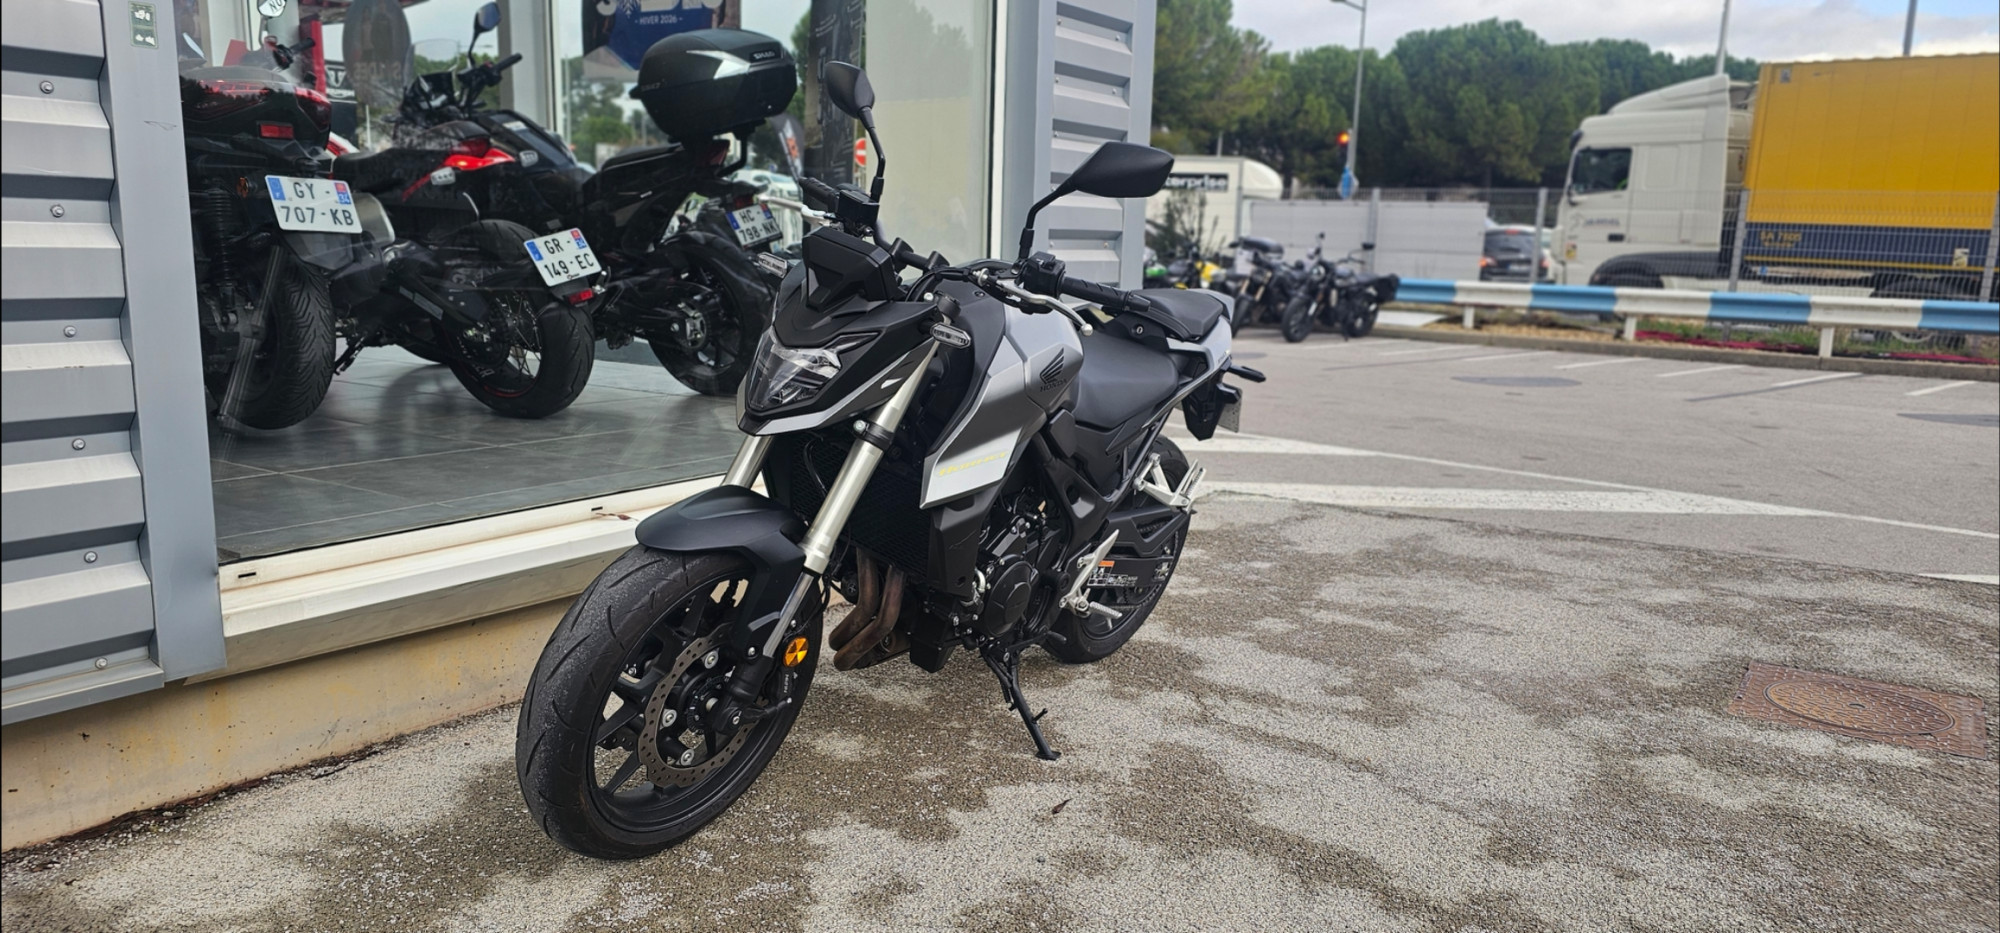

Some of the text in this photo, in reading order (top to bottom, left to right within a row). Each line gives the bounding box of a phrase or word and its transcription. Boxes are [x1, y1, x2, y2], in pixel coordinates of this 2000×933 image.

[639, 15, 659, 25] HIVER
[660, 14, 678, 24] 2026
[1164, 173, 1226, 190] terprise
[280, 205, 354, 226] 707-KB
[544, 253, 595, 279] 149-EC
[1040, 378, 1068, 392] HONDA
